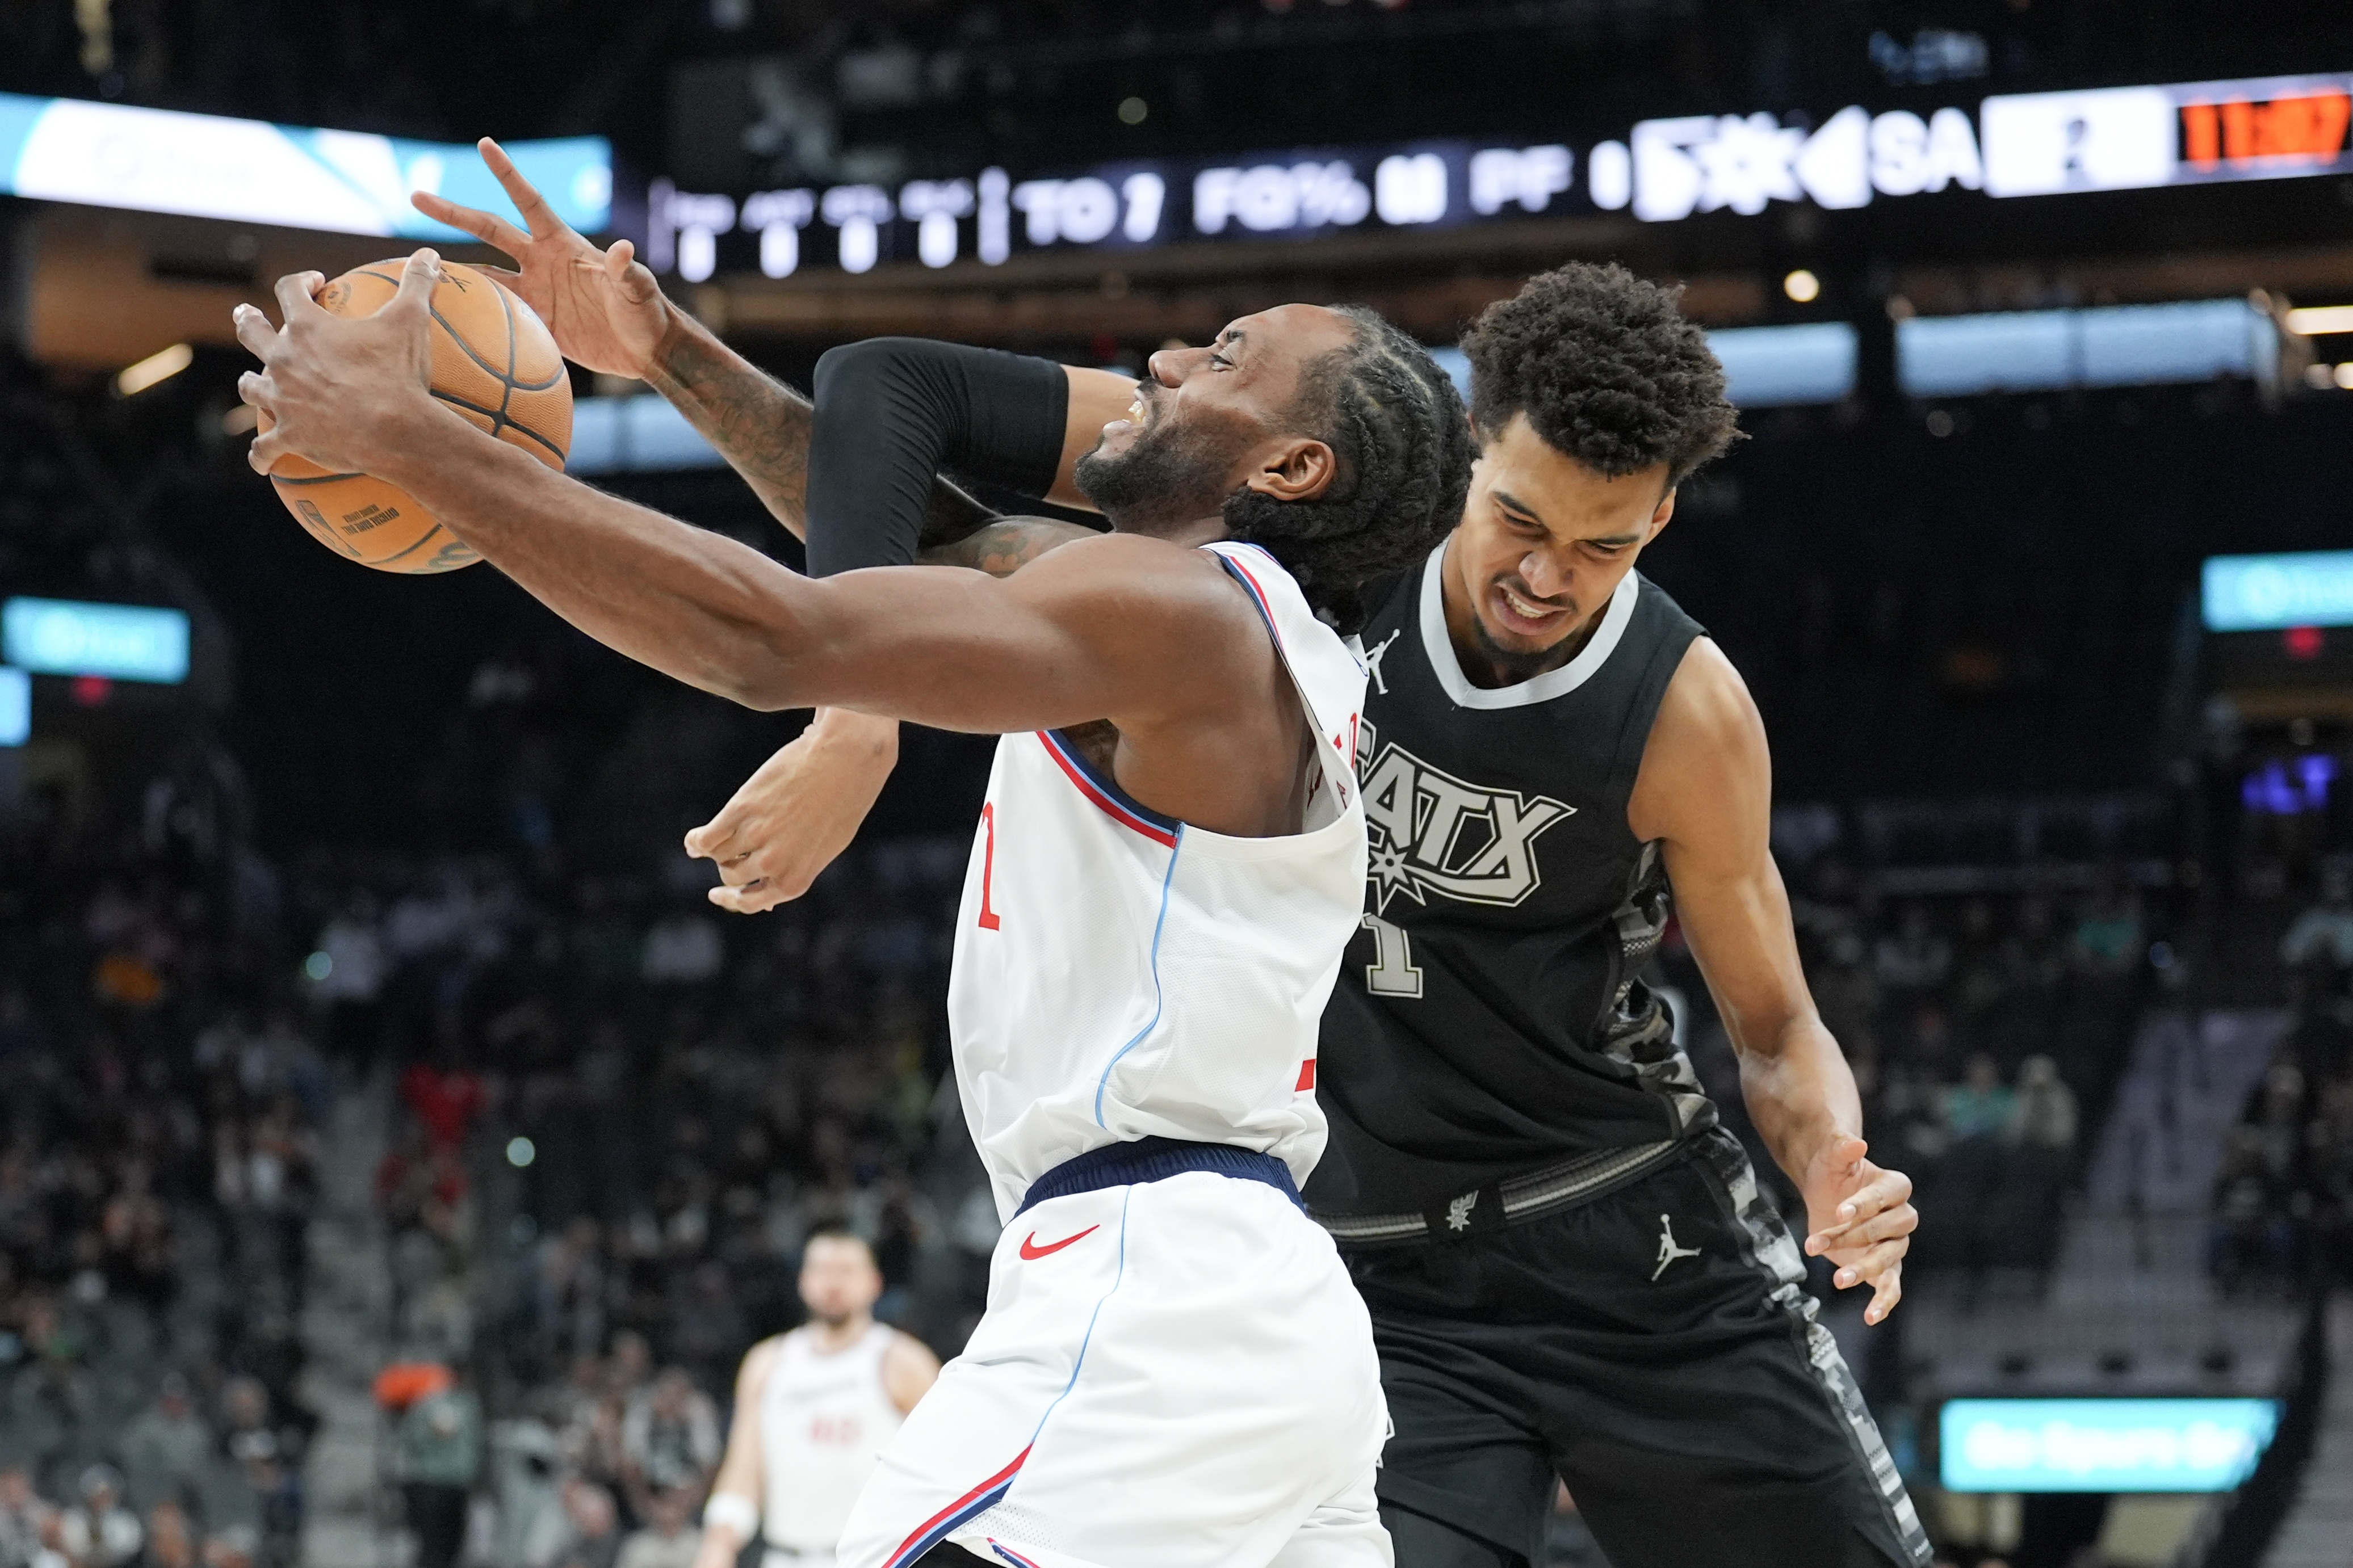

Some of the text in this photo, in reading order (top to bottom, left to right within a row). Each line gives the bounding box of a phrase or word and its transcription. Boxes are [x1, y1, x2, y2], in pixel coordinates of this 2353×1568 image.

[1012, 178, 1118, 245] TO
[1870, 108, 1983, 196] SA
[1362, 913, 1423, 999] 1
